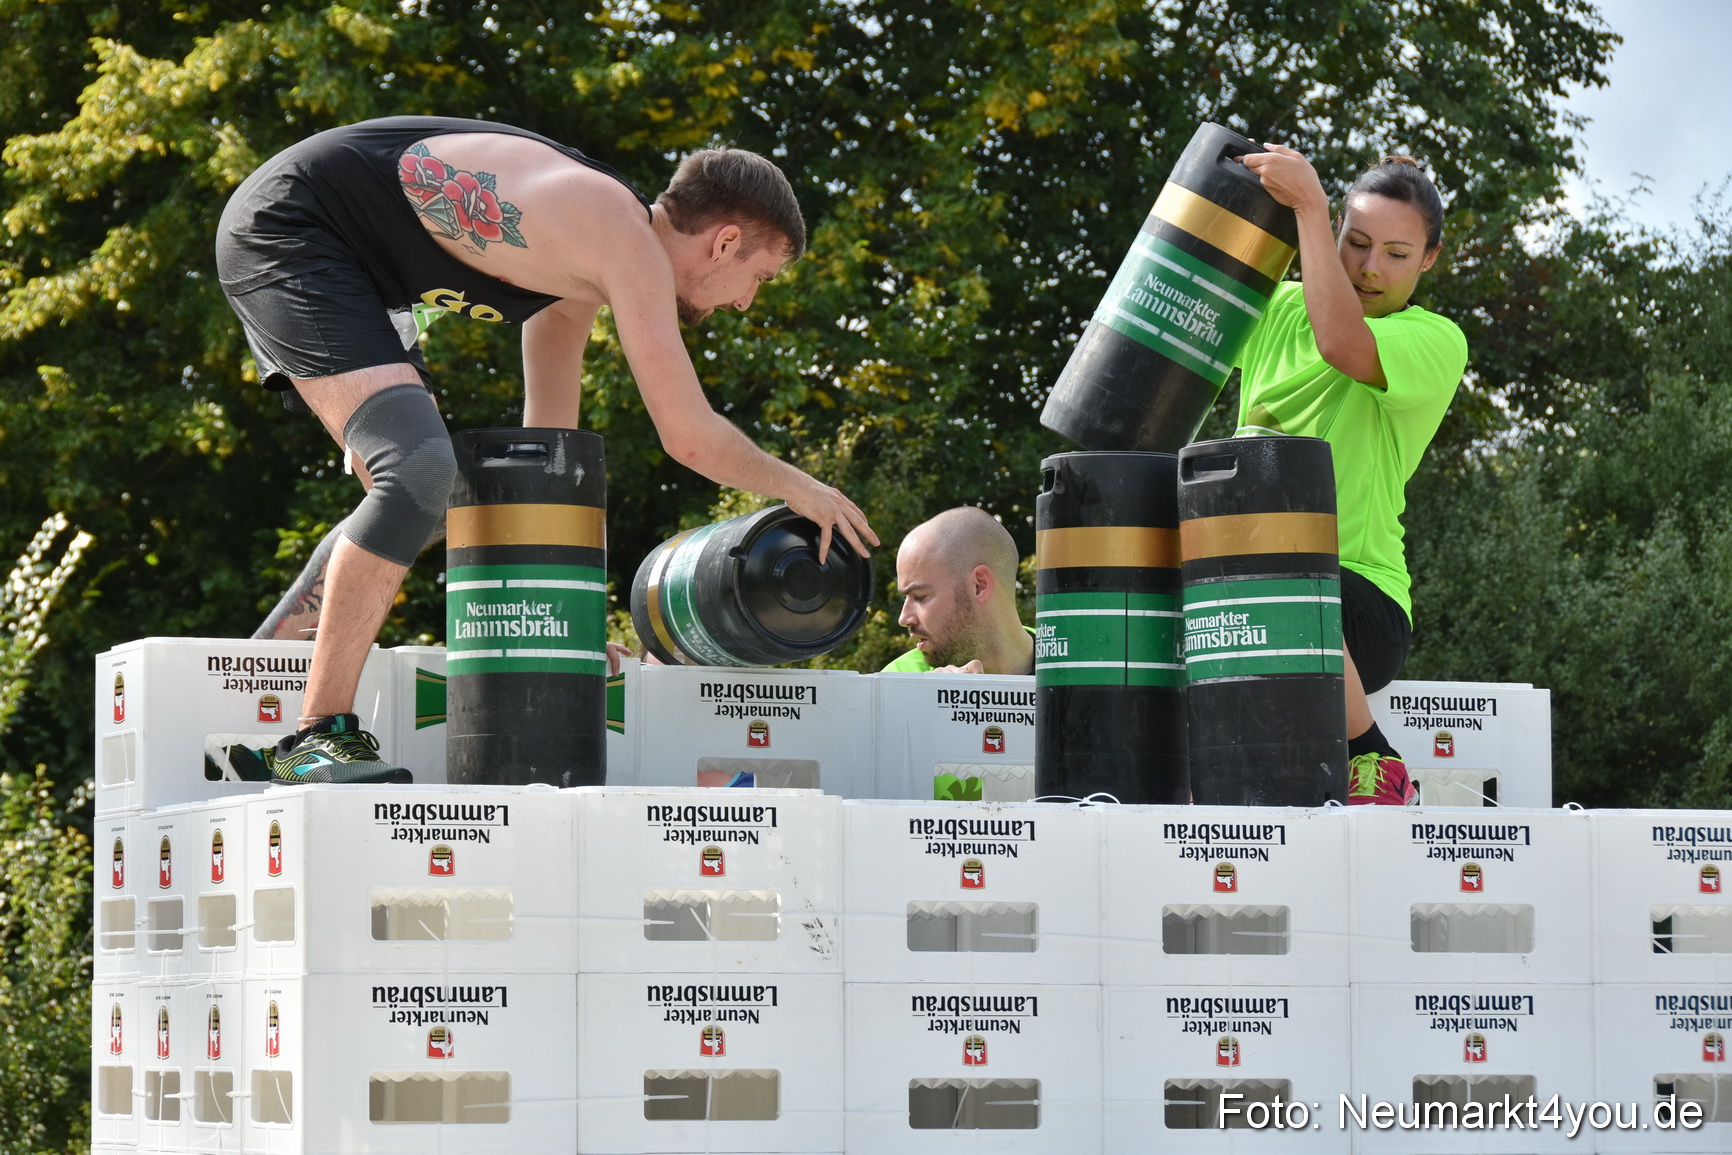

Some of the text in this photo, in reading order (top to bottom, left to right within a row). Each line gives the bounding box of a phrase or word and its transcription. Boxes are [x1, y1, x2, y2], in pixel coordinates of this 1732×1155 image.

[1144, 273, 1220, 323] Neumarkter
[1122, 281, 1224, 347] Lammsbräu
[466, 600, 552, 617] Neumarkter
[455, 615, 568, 639] Lammsbräu
[1184, 612, 1249, 631] Neumarkter
[1184, 626, 1267, 651] ammsbräu
[208, 656, 312, 676] mmsbräu
[700, 683, 816, 704] Lammsbräu
[938, 690, 1037, 710] ammsbräu
[715, 705, 800, 720] Neumarkter
[1390, 696, 1497, 716] Lammsbräu
[1403, 717, 1482, 731] Neumarkter
[375, 804, 508, 826] Lammsbräu
[648, 806, 776, 827] Lammsbräu
[391, 828, 490, 845] Neumarkter
[664, 830, 758, 845] Neumarkter
[910, 819, 1034, 840] Lammsbräu
[1164, 824, 1285, 845] Lammsbräu
[1412, 824, 1530, 845] Lammsbräu
[1653, 827, 1732, 846] msbräu
[926, 843, 1017, 857] Neumarkter
[1180, 847, 1268, 862] Neumarkter
[1427, 847, 1513, 861] Neumarkter
[1668, 850, 1731, 863] umarkter
[373, 987, 507, 1008] Lammsbräu
[648, 986, 777, 1006] Lammsbräu
[1416, 996, 1533, 1015] Lammsbräu
[912, 996, 1037, 1016] Lammsbräu
[1167, 998, 1288, 1018] Lammsbräu
[389, 1009, 489, 1026] Neumarkter
[664, 1010, 759, 1025] Neumarkter
[928, 1020, 1020, 1034] Neumarkter
[1431, 1018, 1516, 1032] Neumarkter
[1671, 1018, 1731, 1032] umarkter
[1183, 1021, 1271, 1035] Neumarkter
